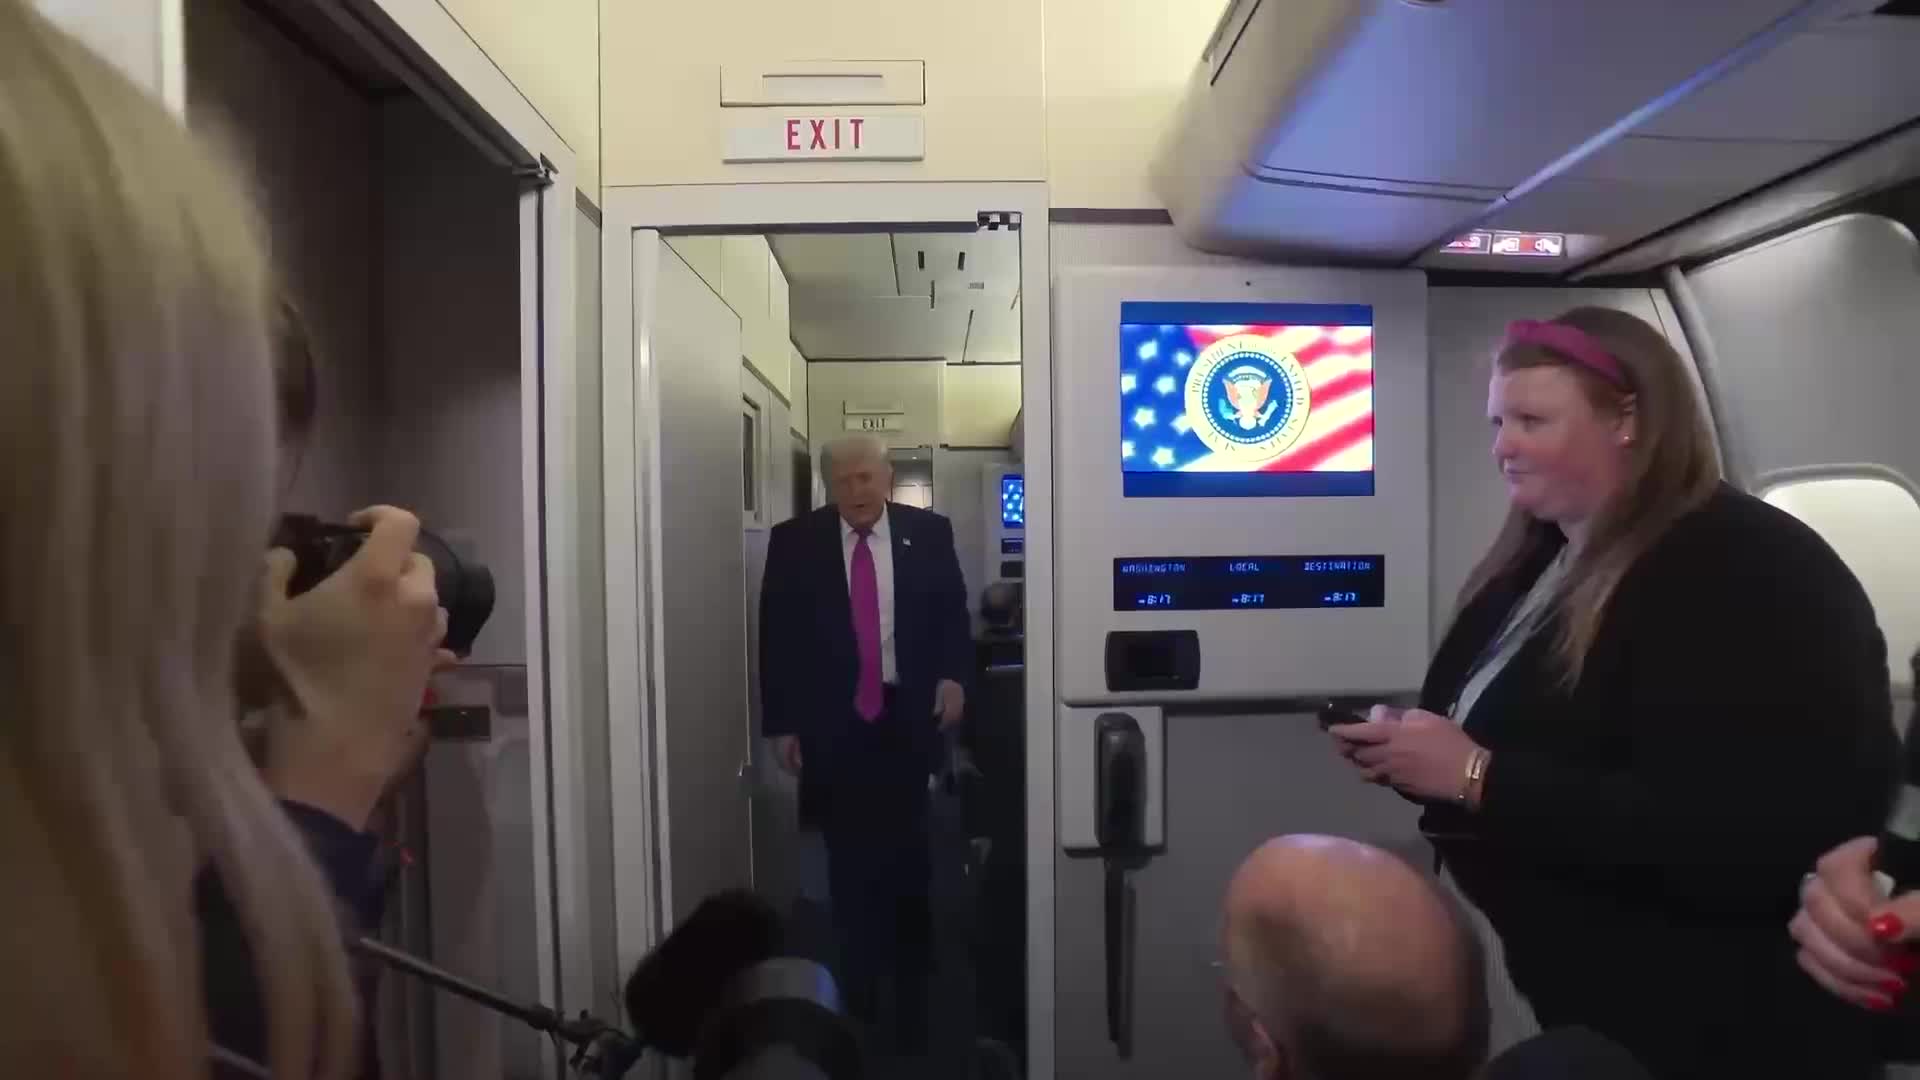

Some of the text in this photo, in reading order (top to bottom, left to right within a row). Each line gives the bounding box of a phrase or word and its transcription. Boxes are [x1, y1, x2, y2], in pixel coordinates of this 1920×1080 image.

[787, 118, 864, 150] EXIT
[862, 417, 886, 430] EXIT
[1121, 563, 1186, 574] WASHINGTON
[1229, 562, 1260, 573] LOCAL
[1303, 560, 1372, 572] DESTINATION
